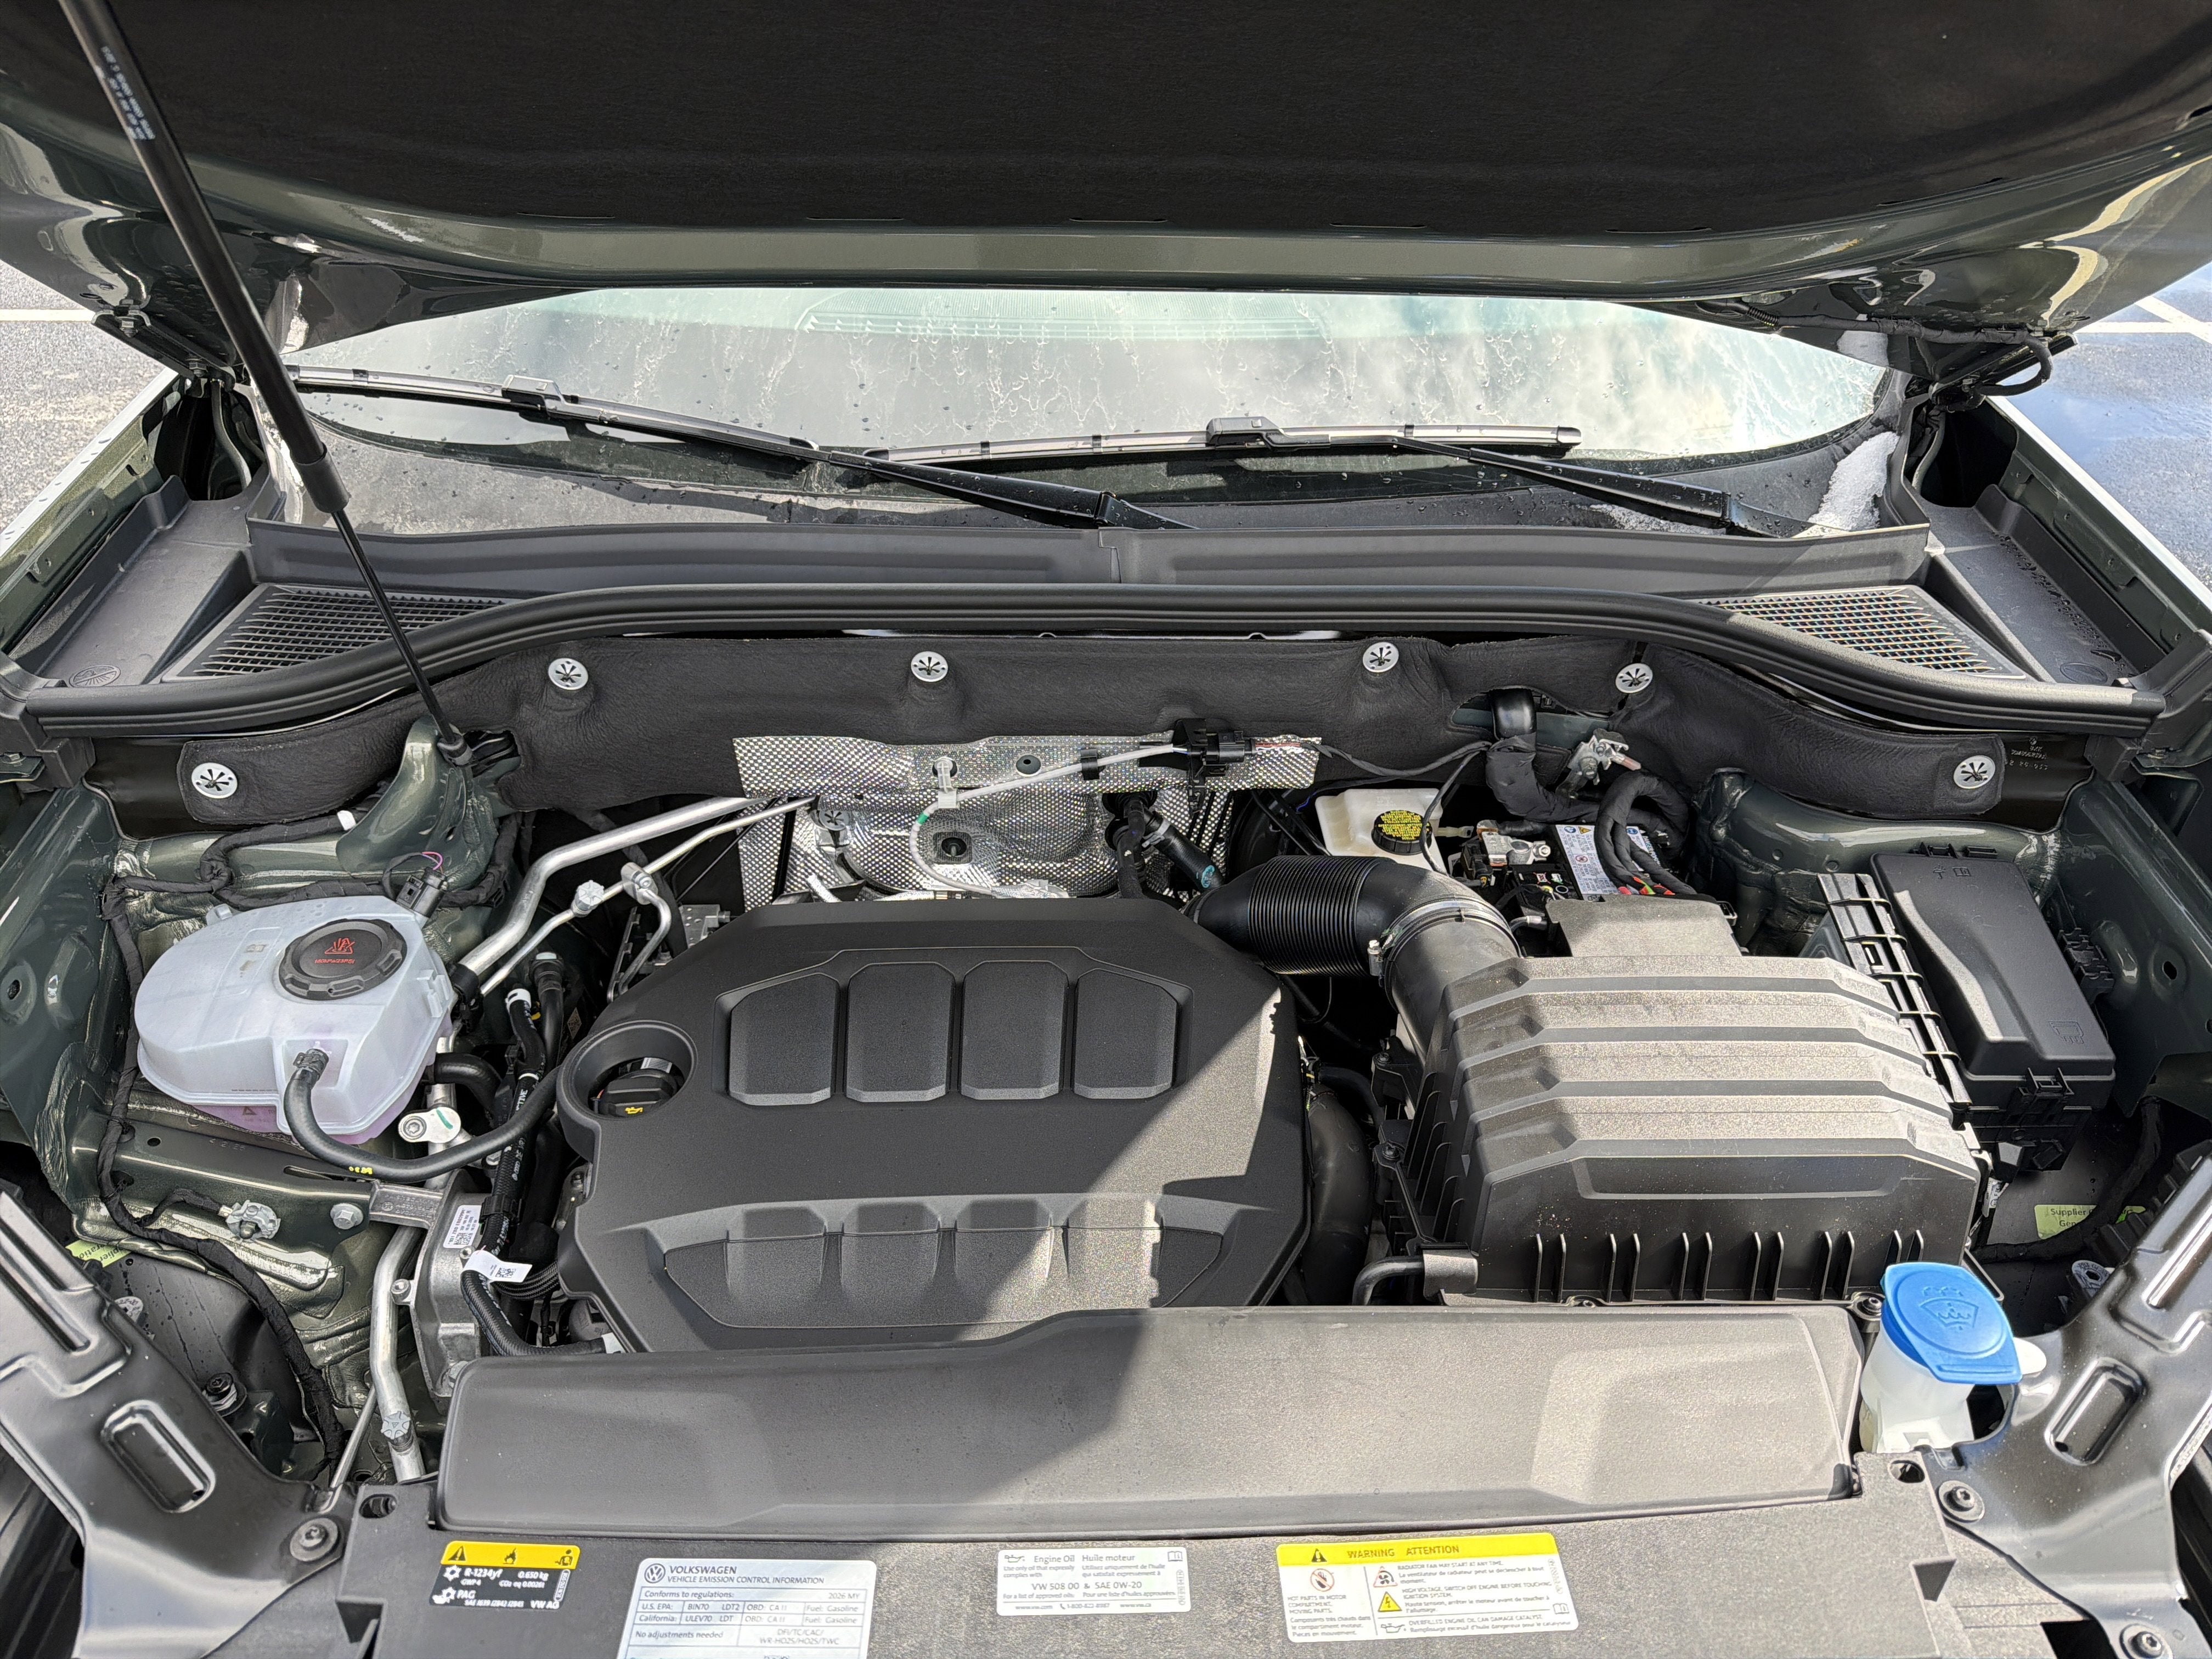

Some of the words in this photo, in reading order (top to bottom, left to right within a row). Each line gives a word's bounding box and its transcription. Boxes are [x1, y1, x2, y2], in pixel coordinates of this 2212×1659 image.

[79, 1245, 106, 1259] eratio
[100, 1245, 123, 1261] plier
[1347, 1548, 1395, 1559] WARNING
[1406, 1545, 1459, 1556] ATTENTION
[1034, 1555, 1062, 1564] Engine
[464, 1568, 503, 1580] R-1234yf
[517, 1571, 538, 1579] 0.650
[539, 1571, 549, 1581] kg
[670, 1566, 737, 1575] VOLKSWAGEN
[456, 1590, 476, 1599] PAG
[691, 1590, 734, 1599] regulations:
[531, 1600, 546, 1609] VW
[647, 1631, 694, 1639] adjustments
